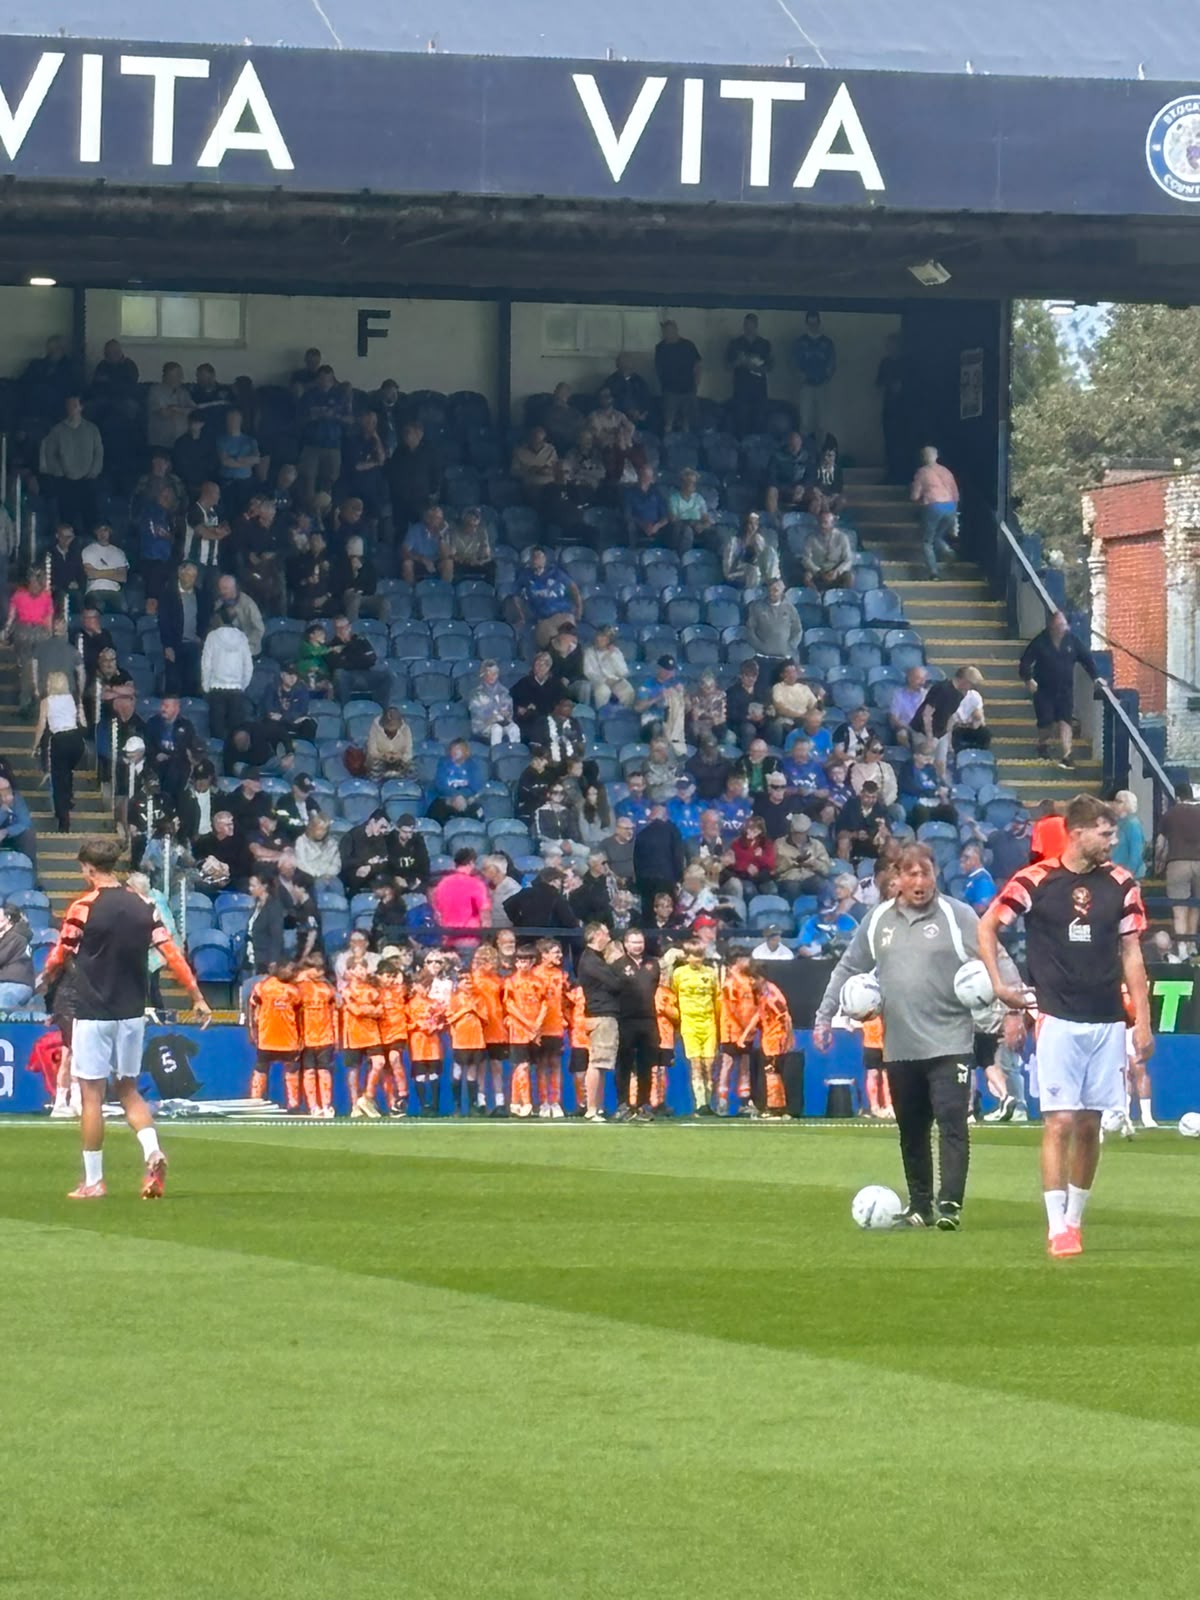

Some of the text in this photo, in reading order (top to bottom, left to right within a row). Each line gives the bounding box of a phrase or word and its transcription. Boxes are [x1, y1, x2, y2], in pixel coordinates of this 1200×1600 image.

[0, 53, 294, 169] VITA
[573, 74, 885, 190] VITA
[357, 309, 391, 357] F
[1153, 981, 1194, 1032] T
